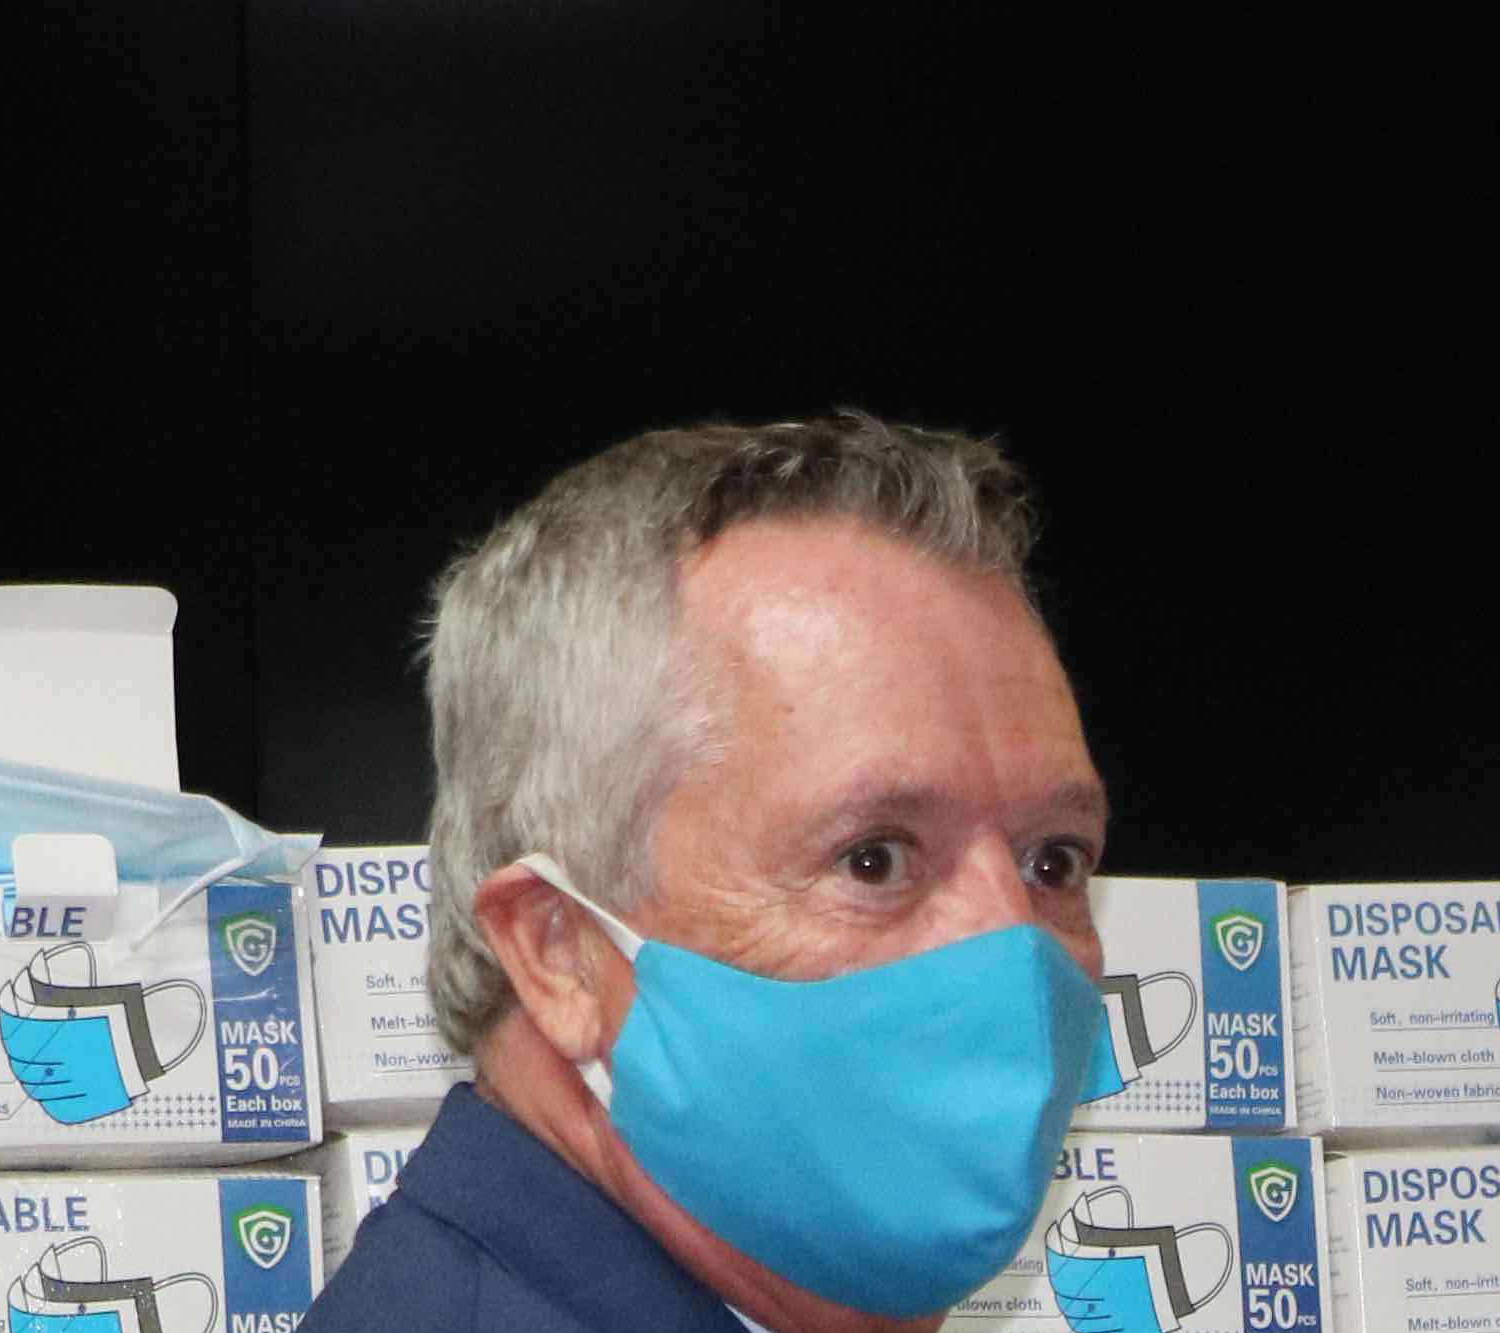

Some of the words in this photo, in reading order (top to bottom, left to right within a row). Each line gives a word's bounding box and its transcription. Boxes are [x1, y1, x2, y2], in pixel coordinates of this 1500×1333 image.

[320, 903, 424, 944] MAS
[1331, 944, 1450, 981] MASK
[220, 1020, 297, 1045] MASK
[1208, 1012, 1277, 1037] MASK
[223, 1047, 279, 1091] 50
[278, 1075, 300, 1087] PCS
[1209, 1037, 1259, 1080] 50
[225, 1095, 266, 1112] Each
[269, 1094, 302, 1111] box
[1209, 1083, 1246, 1099] Each
[1250, 1084, 1279, 1100] box
[1367, 1208, 1485, 1249] MASK
[1245, 1263, 1314, 1287] MASK
[1247, 1287, 1297, 1329] 50
